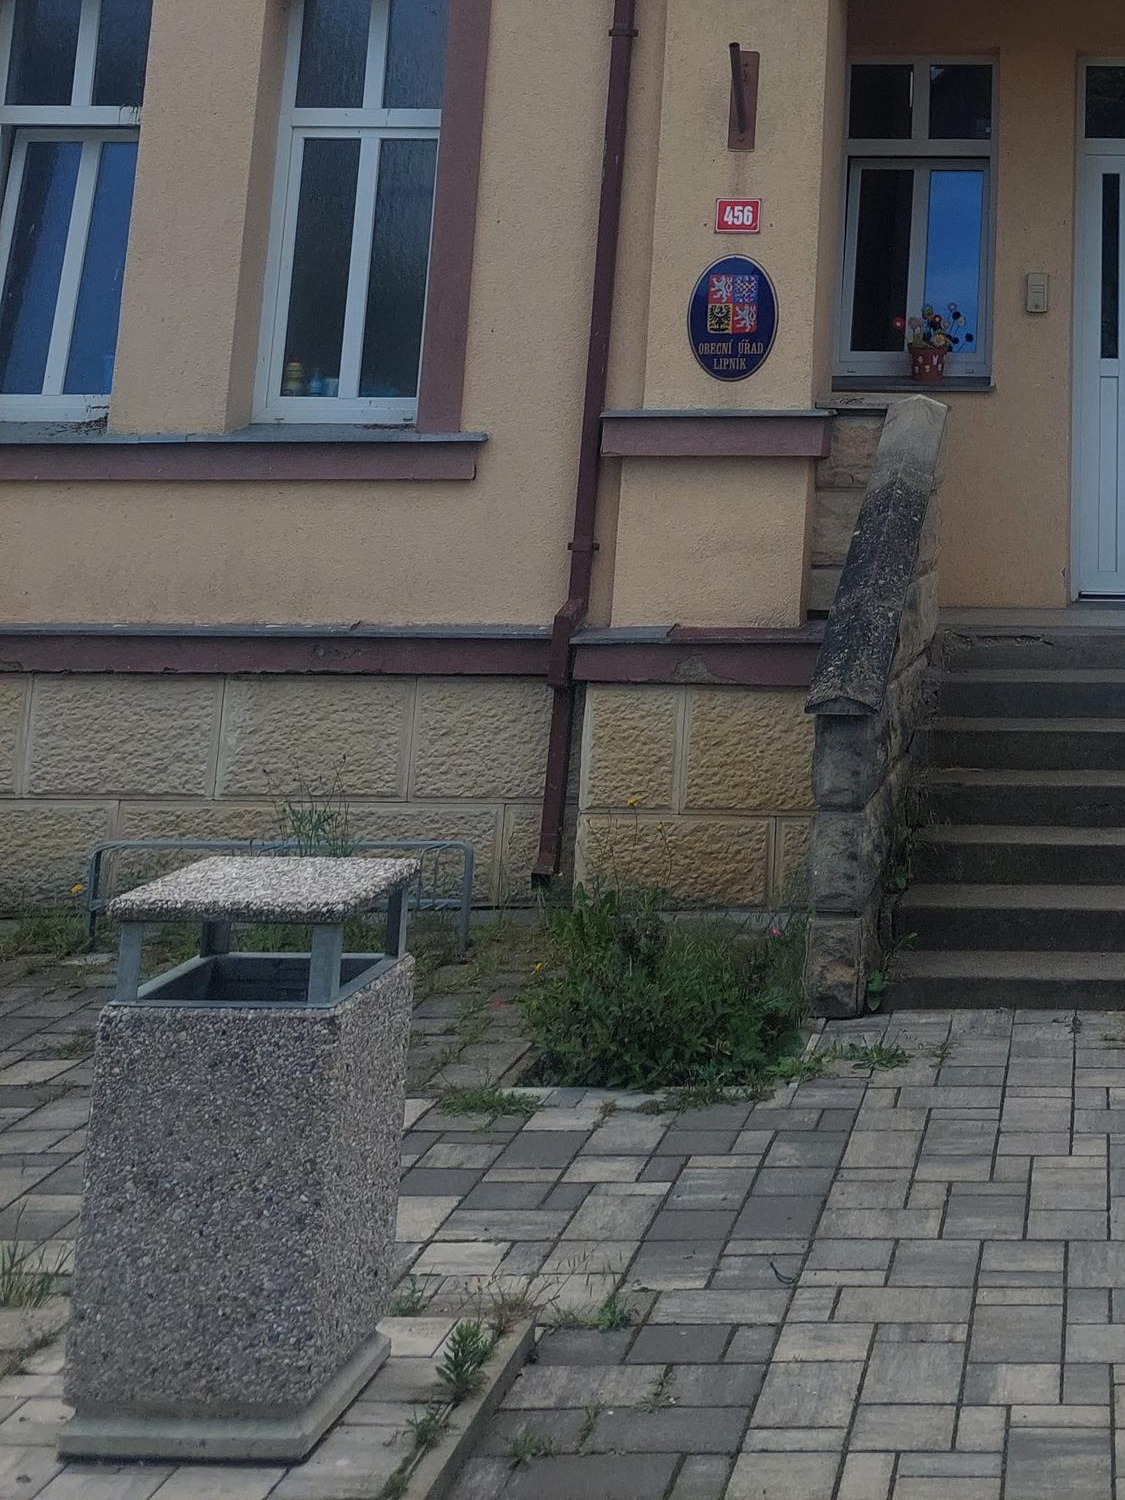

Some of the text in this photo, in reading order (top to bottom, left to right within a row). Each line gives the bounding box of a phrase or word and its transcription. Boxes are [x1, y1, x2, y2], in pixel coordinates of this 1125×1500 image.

[723, 206, 753, 225] 456
[698, 339, 764, 355] OBECNÍ ÚŘAD
[713, 355, 747, 370] LIPNÍK
